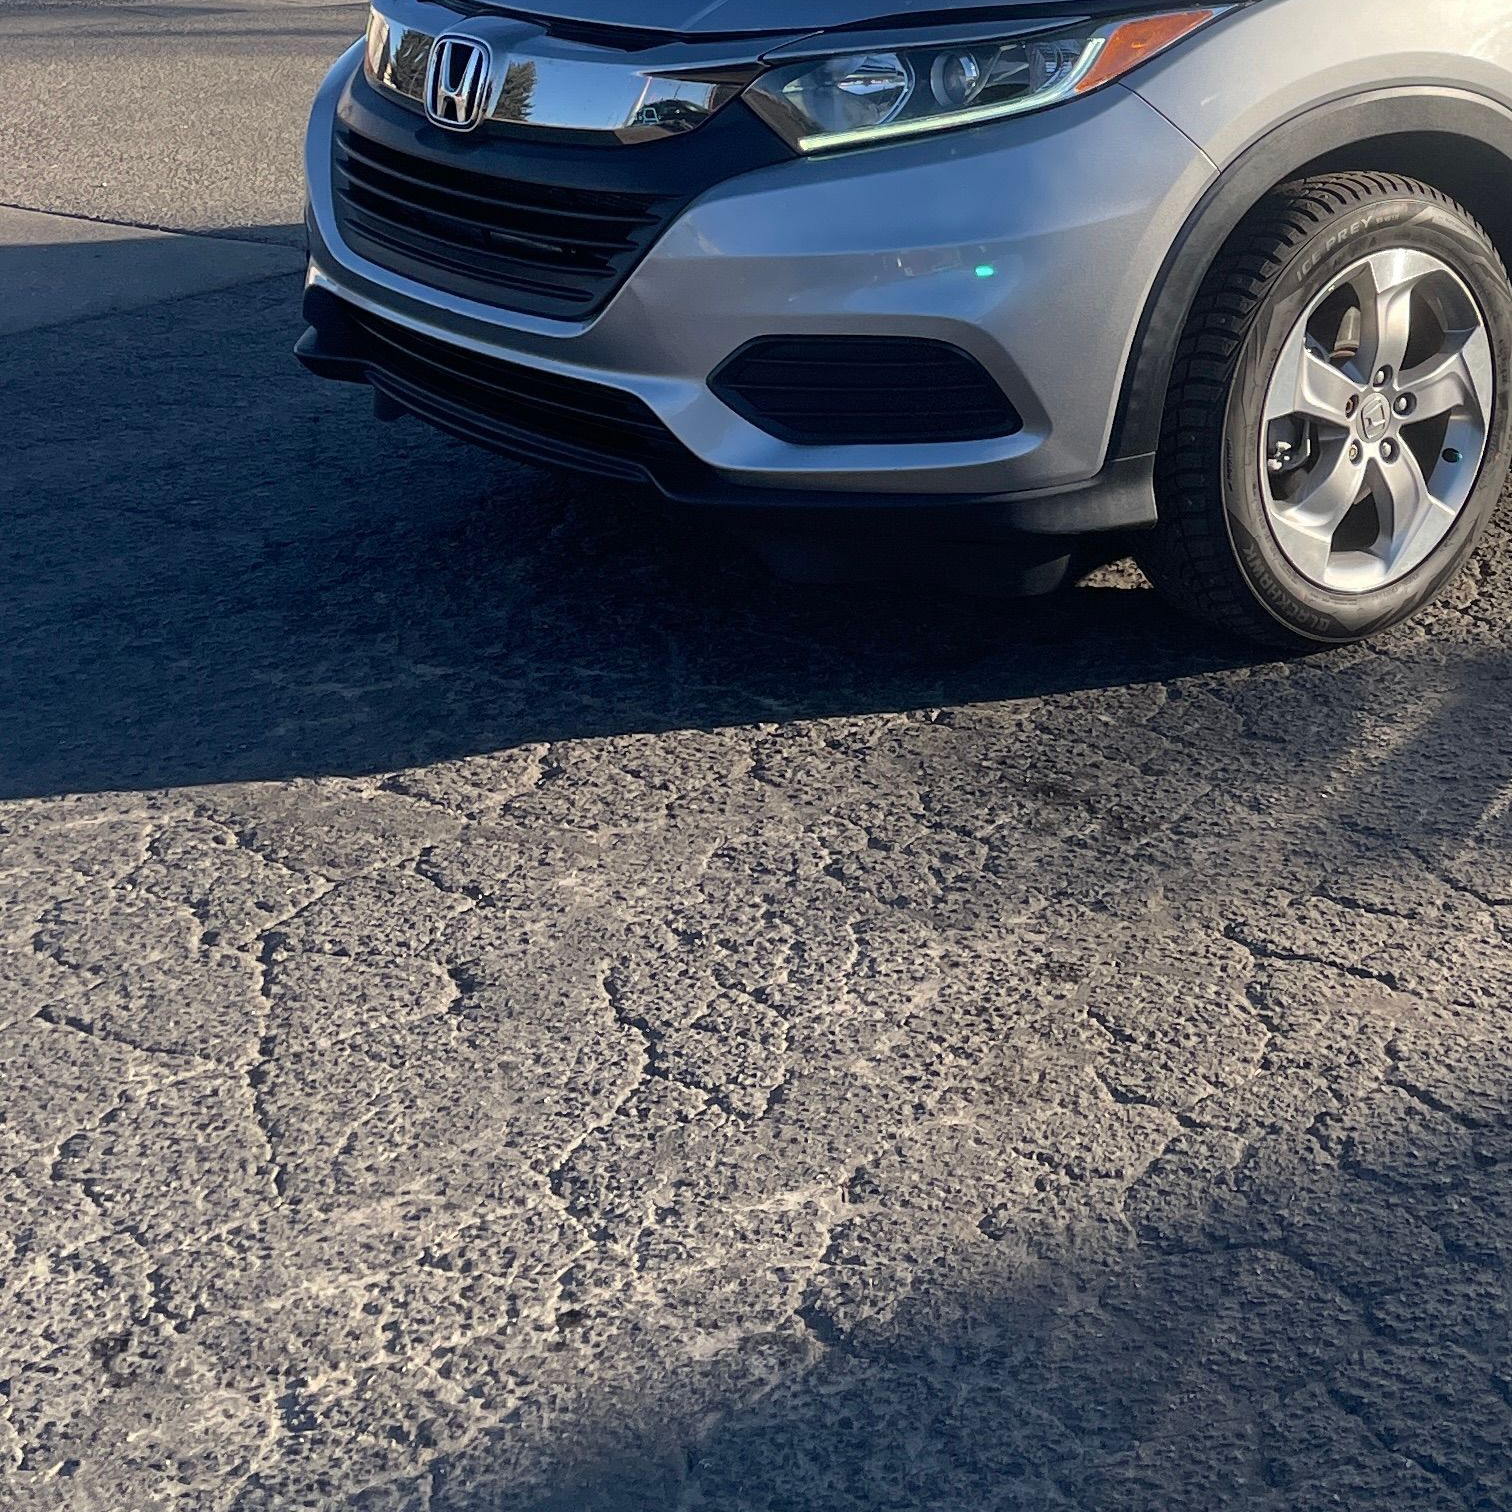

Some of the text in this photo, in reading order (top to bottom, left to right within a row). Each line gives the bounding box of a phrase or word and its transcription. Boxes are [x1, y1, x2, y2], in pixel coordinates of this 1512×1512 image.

[1296, 250, 1322, 282] ICE
[1326, 215, 1373, 252] PREY
[1242, 543, 1331, 632] BLACKHAWK
